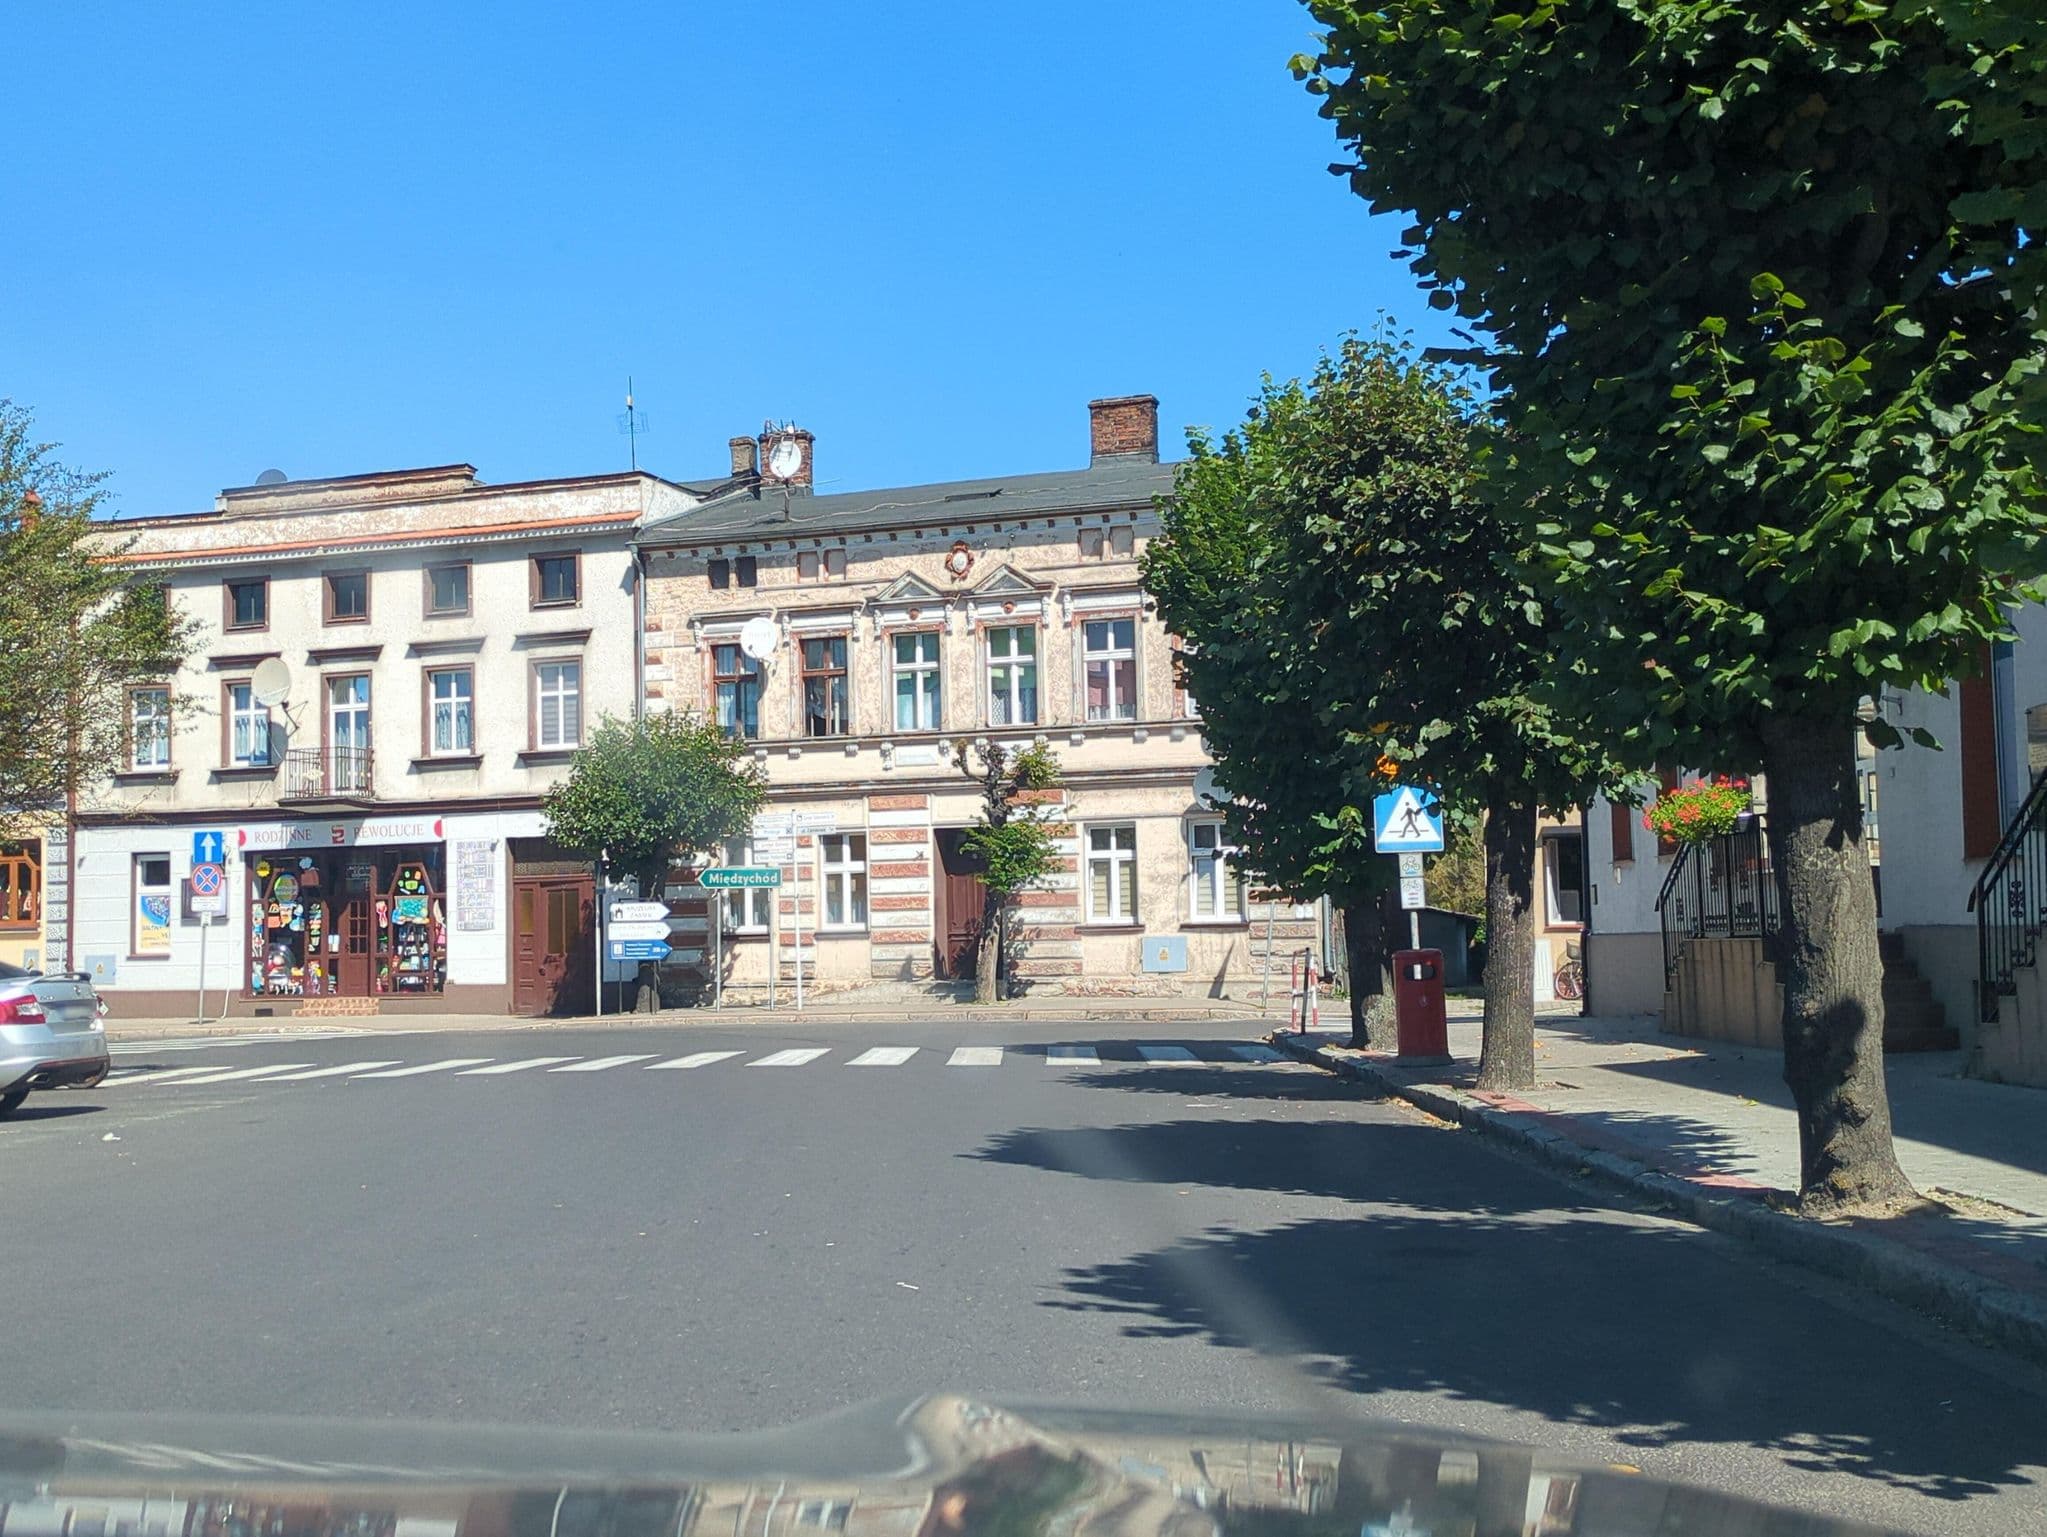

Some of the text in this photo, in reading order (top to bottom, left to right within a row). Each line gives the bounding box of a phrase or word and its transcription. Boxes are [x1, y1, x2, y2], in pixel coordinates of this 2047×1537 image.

[254, 828, 312, 844] RODZINNE
[353, 823, 425, 839] REWOLUCJE
[709, 872, 778, 886] Międzychód
